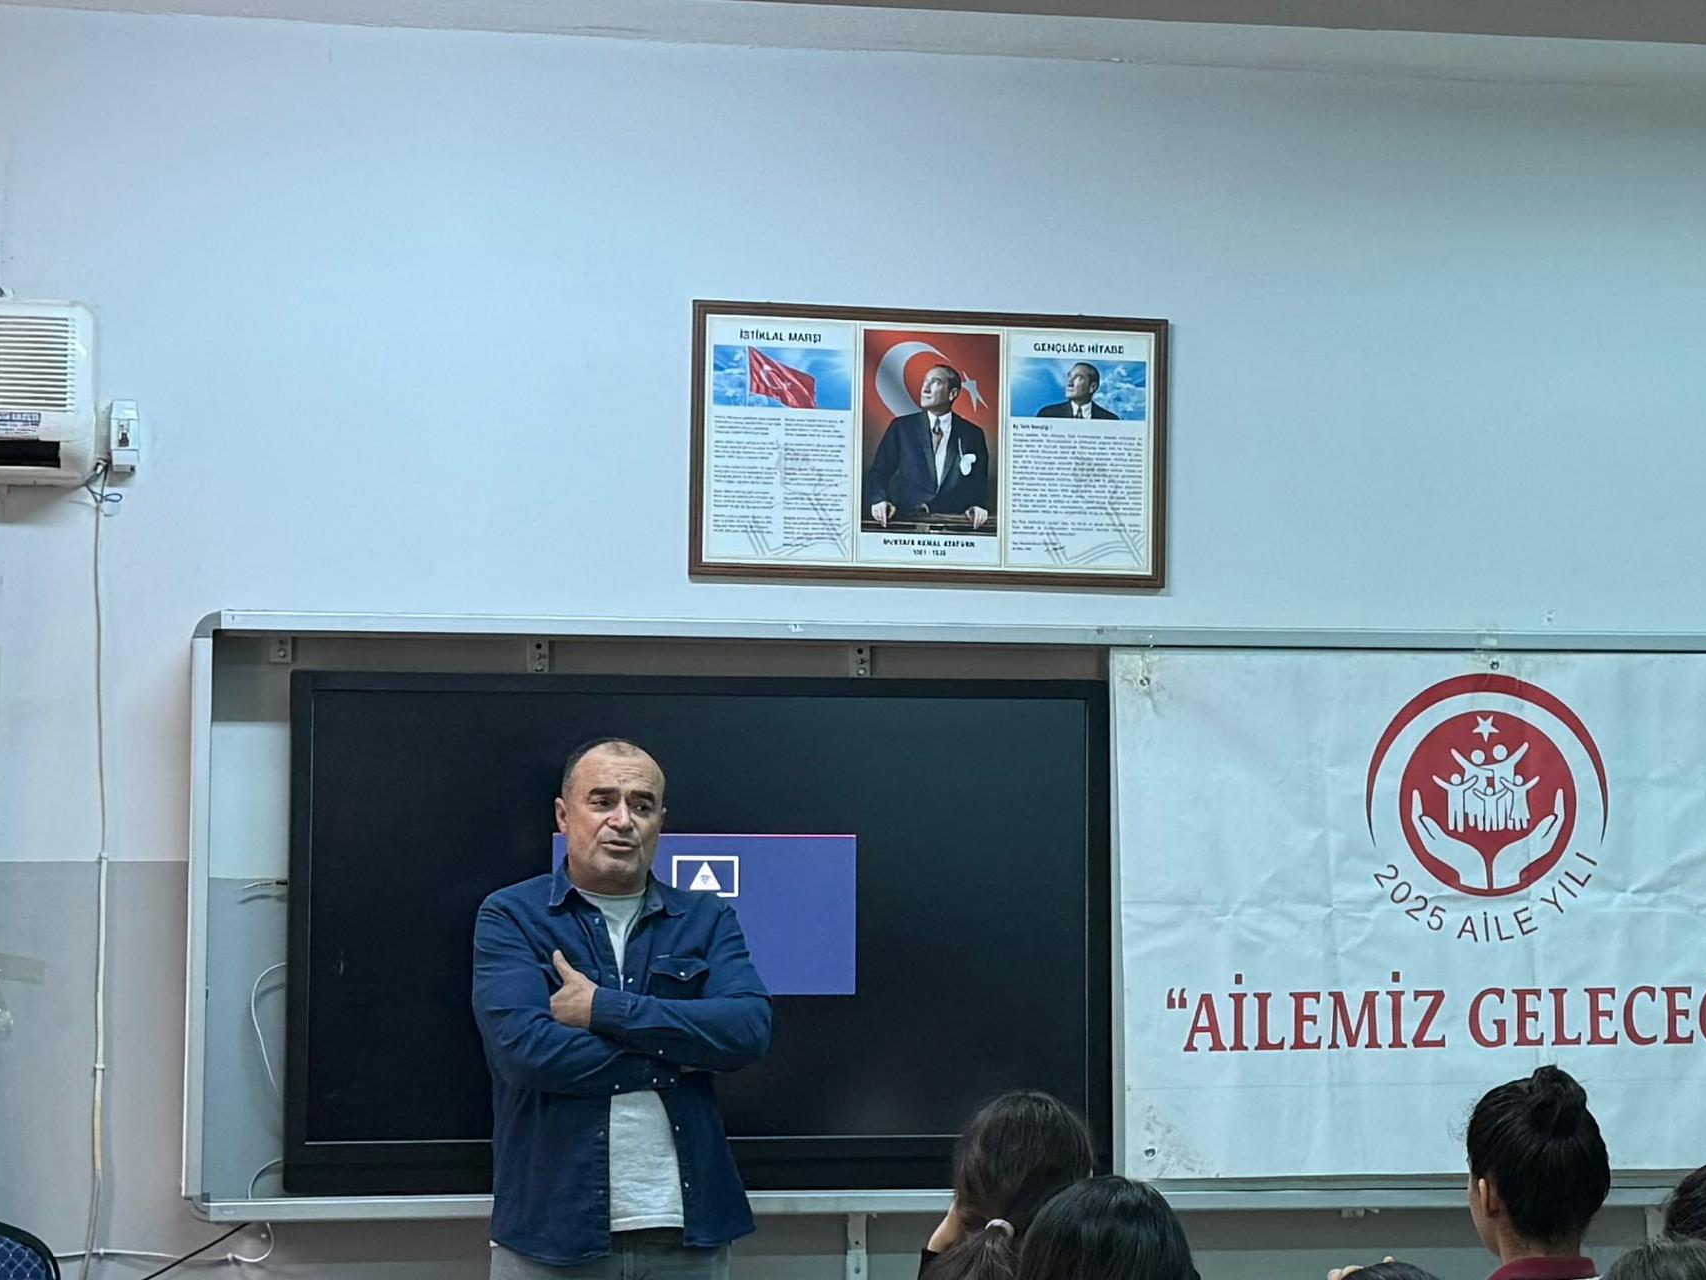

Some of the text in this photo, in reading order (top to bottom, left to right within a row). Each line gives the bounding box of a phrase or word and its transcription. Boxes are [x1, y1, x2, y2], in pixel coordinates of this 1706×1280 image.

[1373, 852, 1598, 943] 2025 AİLE YILI
